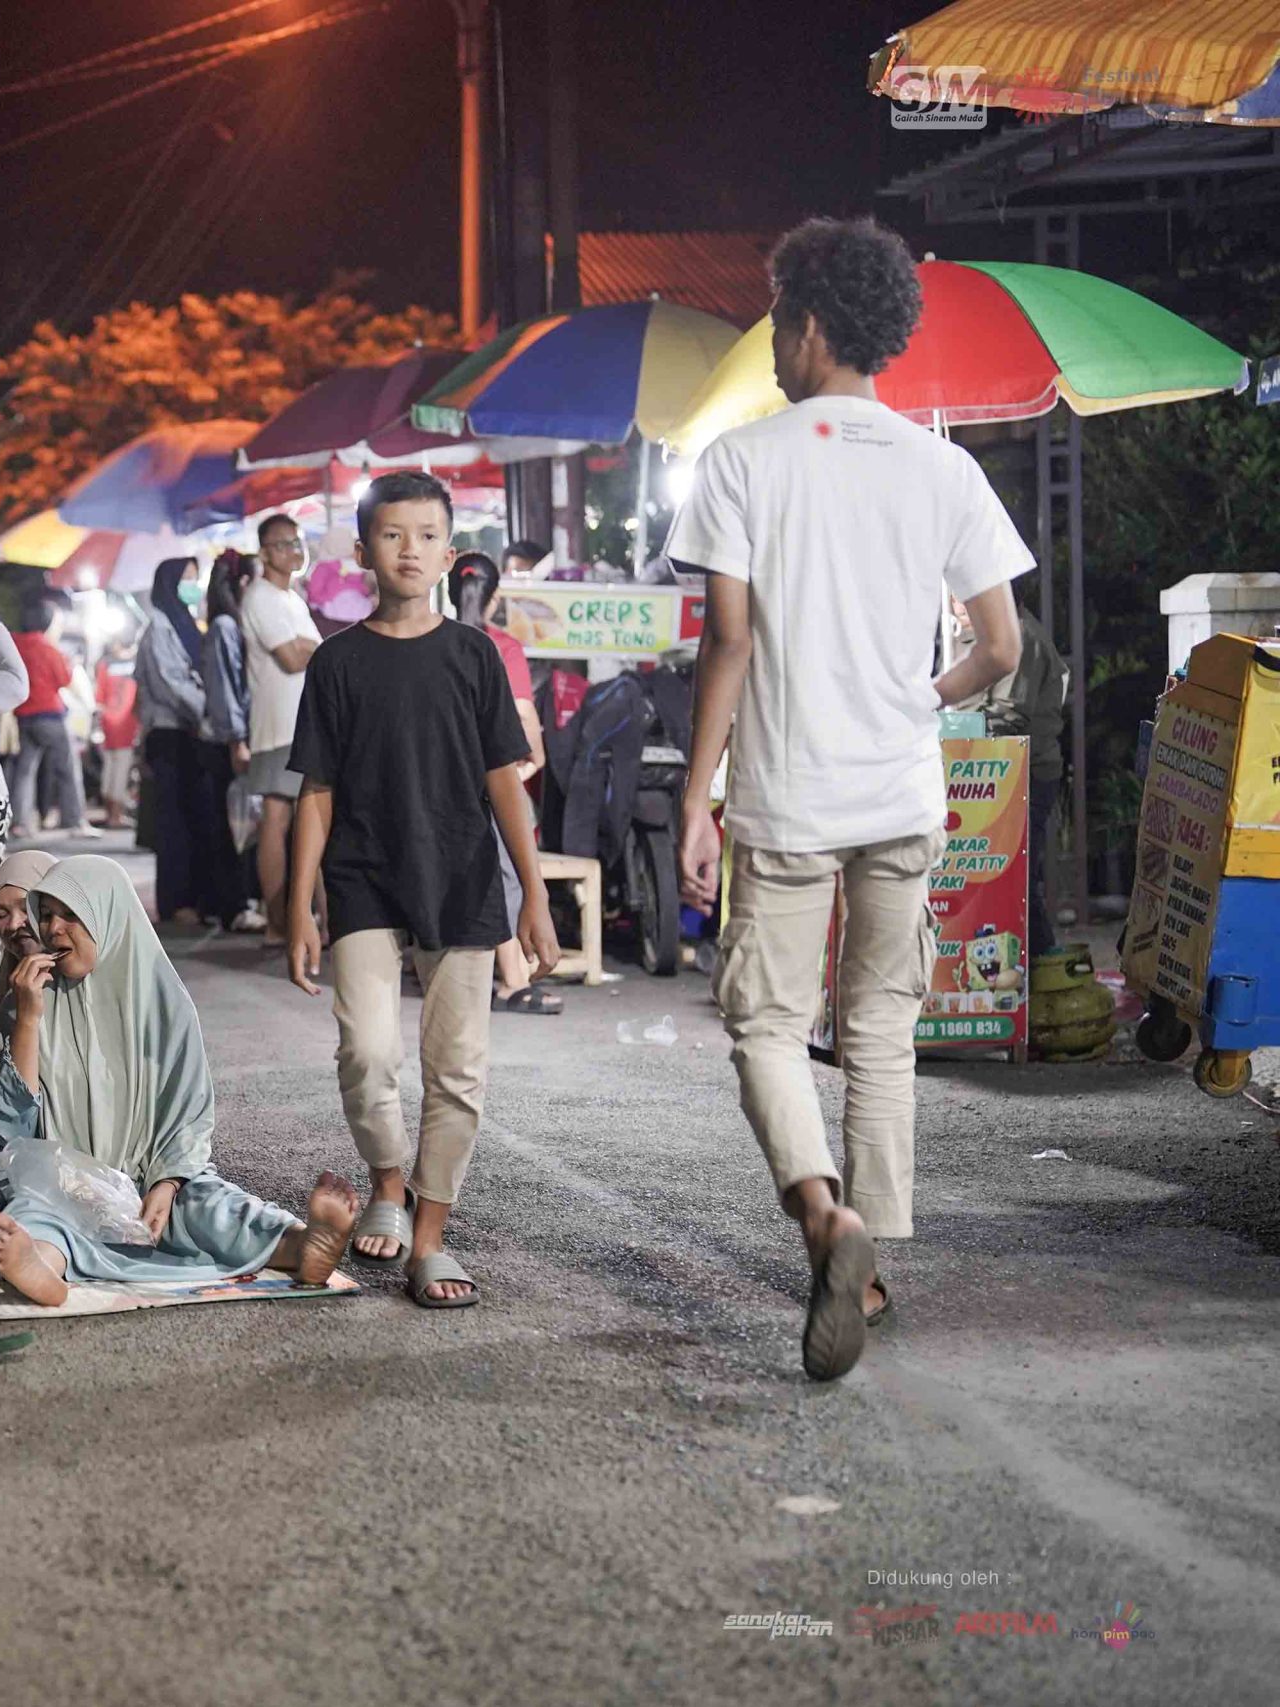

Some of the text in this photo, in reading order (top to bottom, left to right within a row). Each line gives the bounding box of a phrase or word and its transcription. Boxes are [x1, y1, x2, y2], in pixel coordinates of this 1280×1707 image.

[1171, 714, 1218, 757] CILUNG
[949, 760, 1010, 778] PATTY
[946, 782, 996, 799] NUHA
[956, 856, 1007, 871] PATTY
[976, 1020, 1001, 1035] 834
